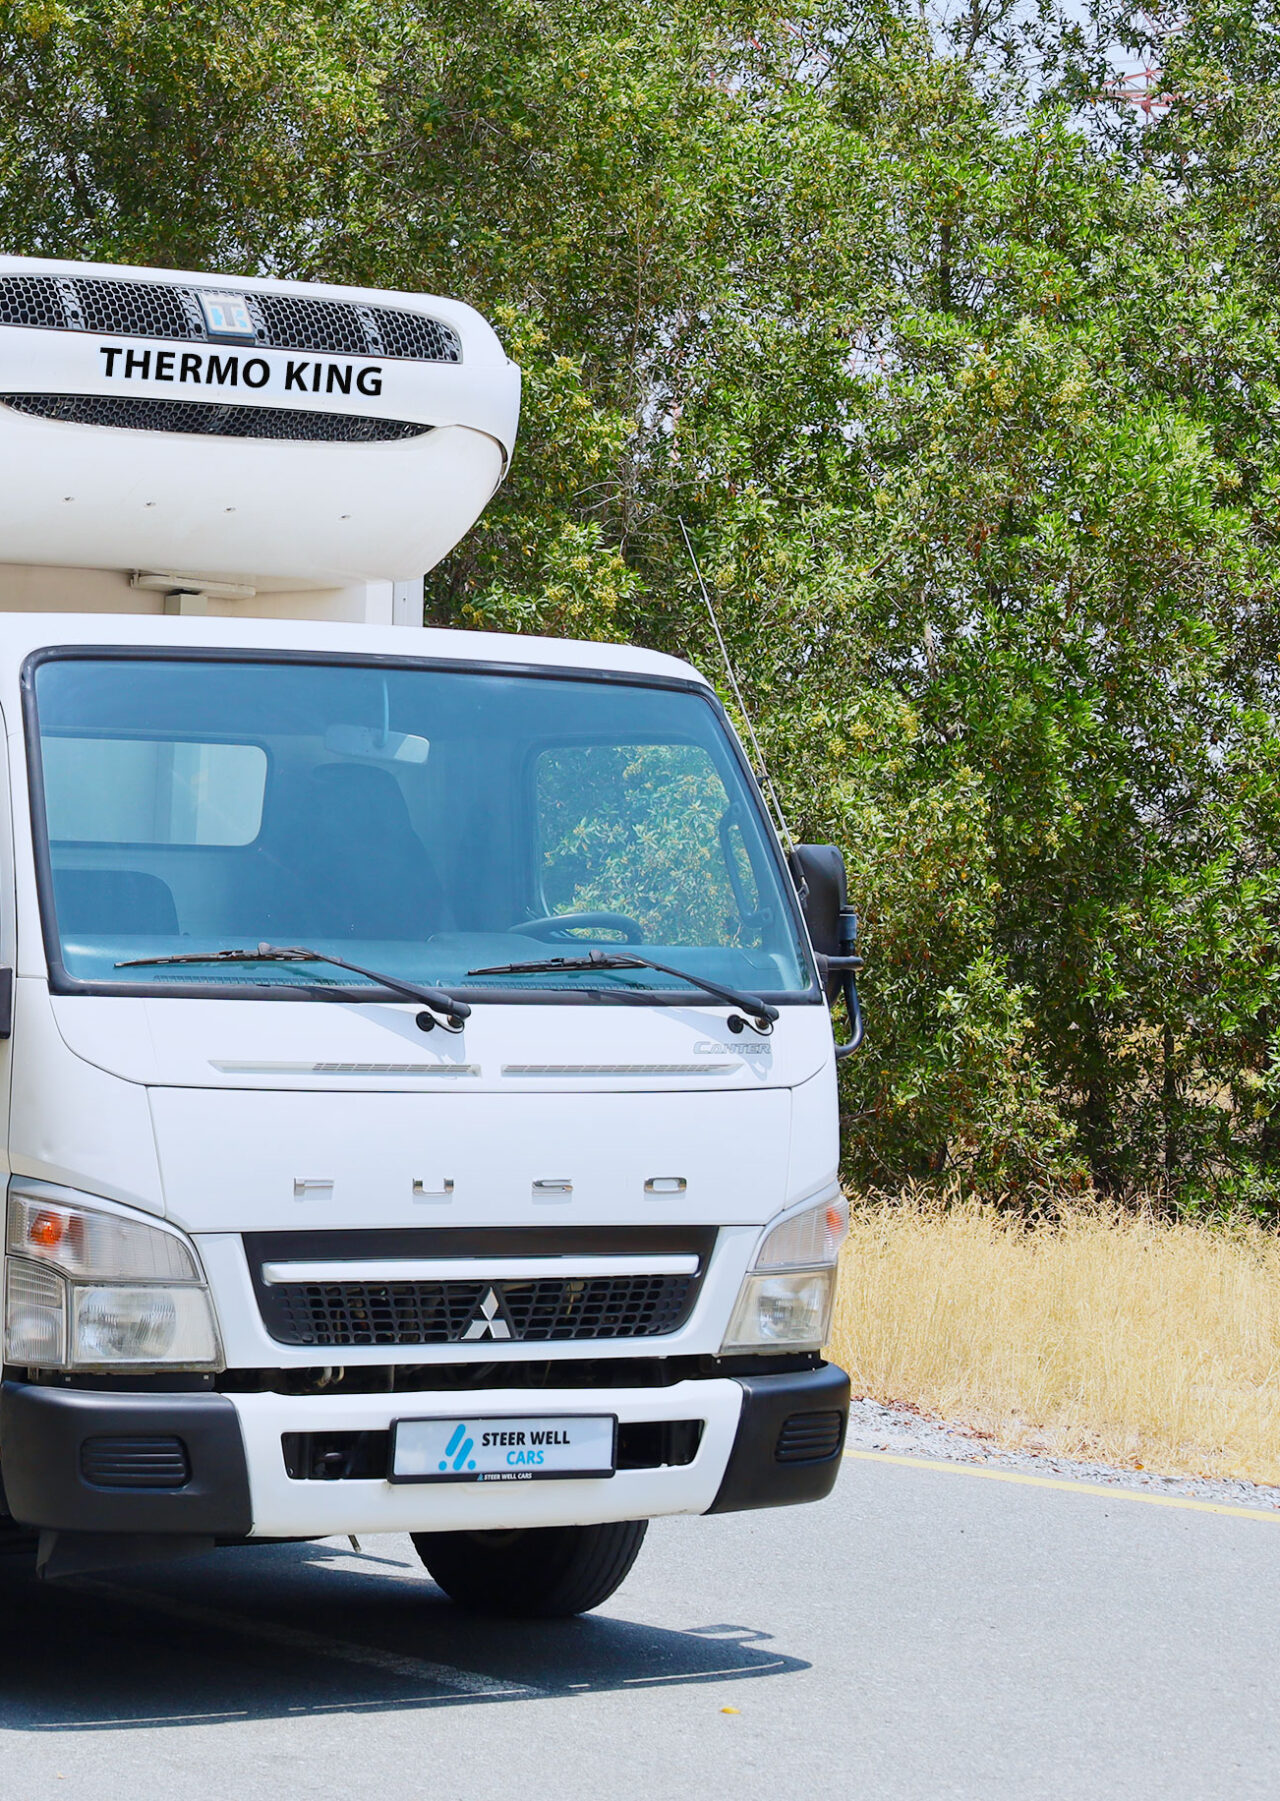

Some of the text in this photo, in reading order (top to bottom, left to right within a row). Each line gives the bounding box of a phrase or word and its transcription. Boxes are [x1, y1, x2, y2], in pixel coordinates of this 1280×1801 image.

[100, 346, 384, 396] THERMO KING
[482, 1431, 570, 1446] STEER WELL
[506, 1450, 544, 1465] CARS
